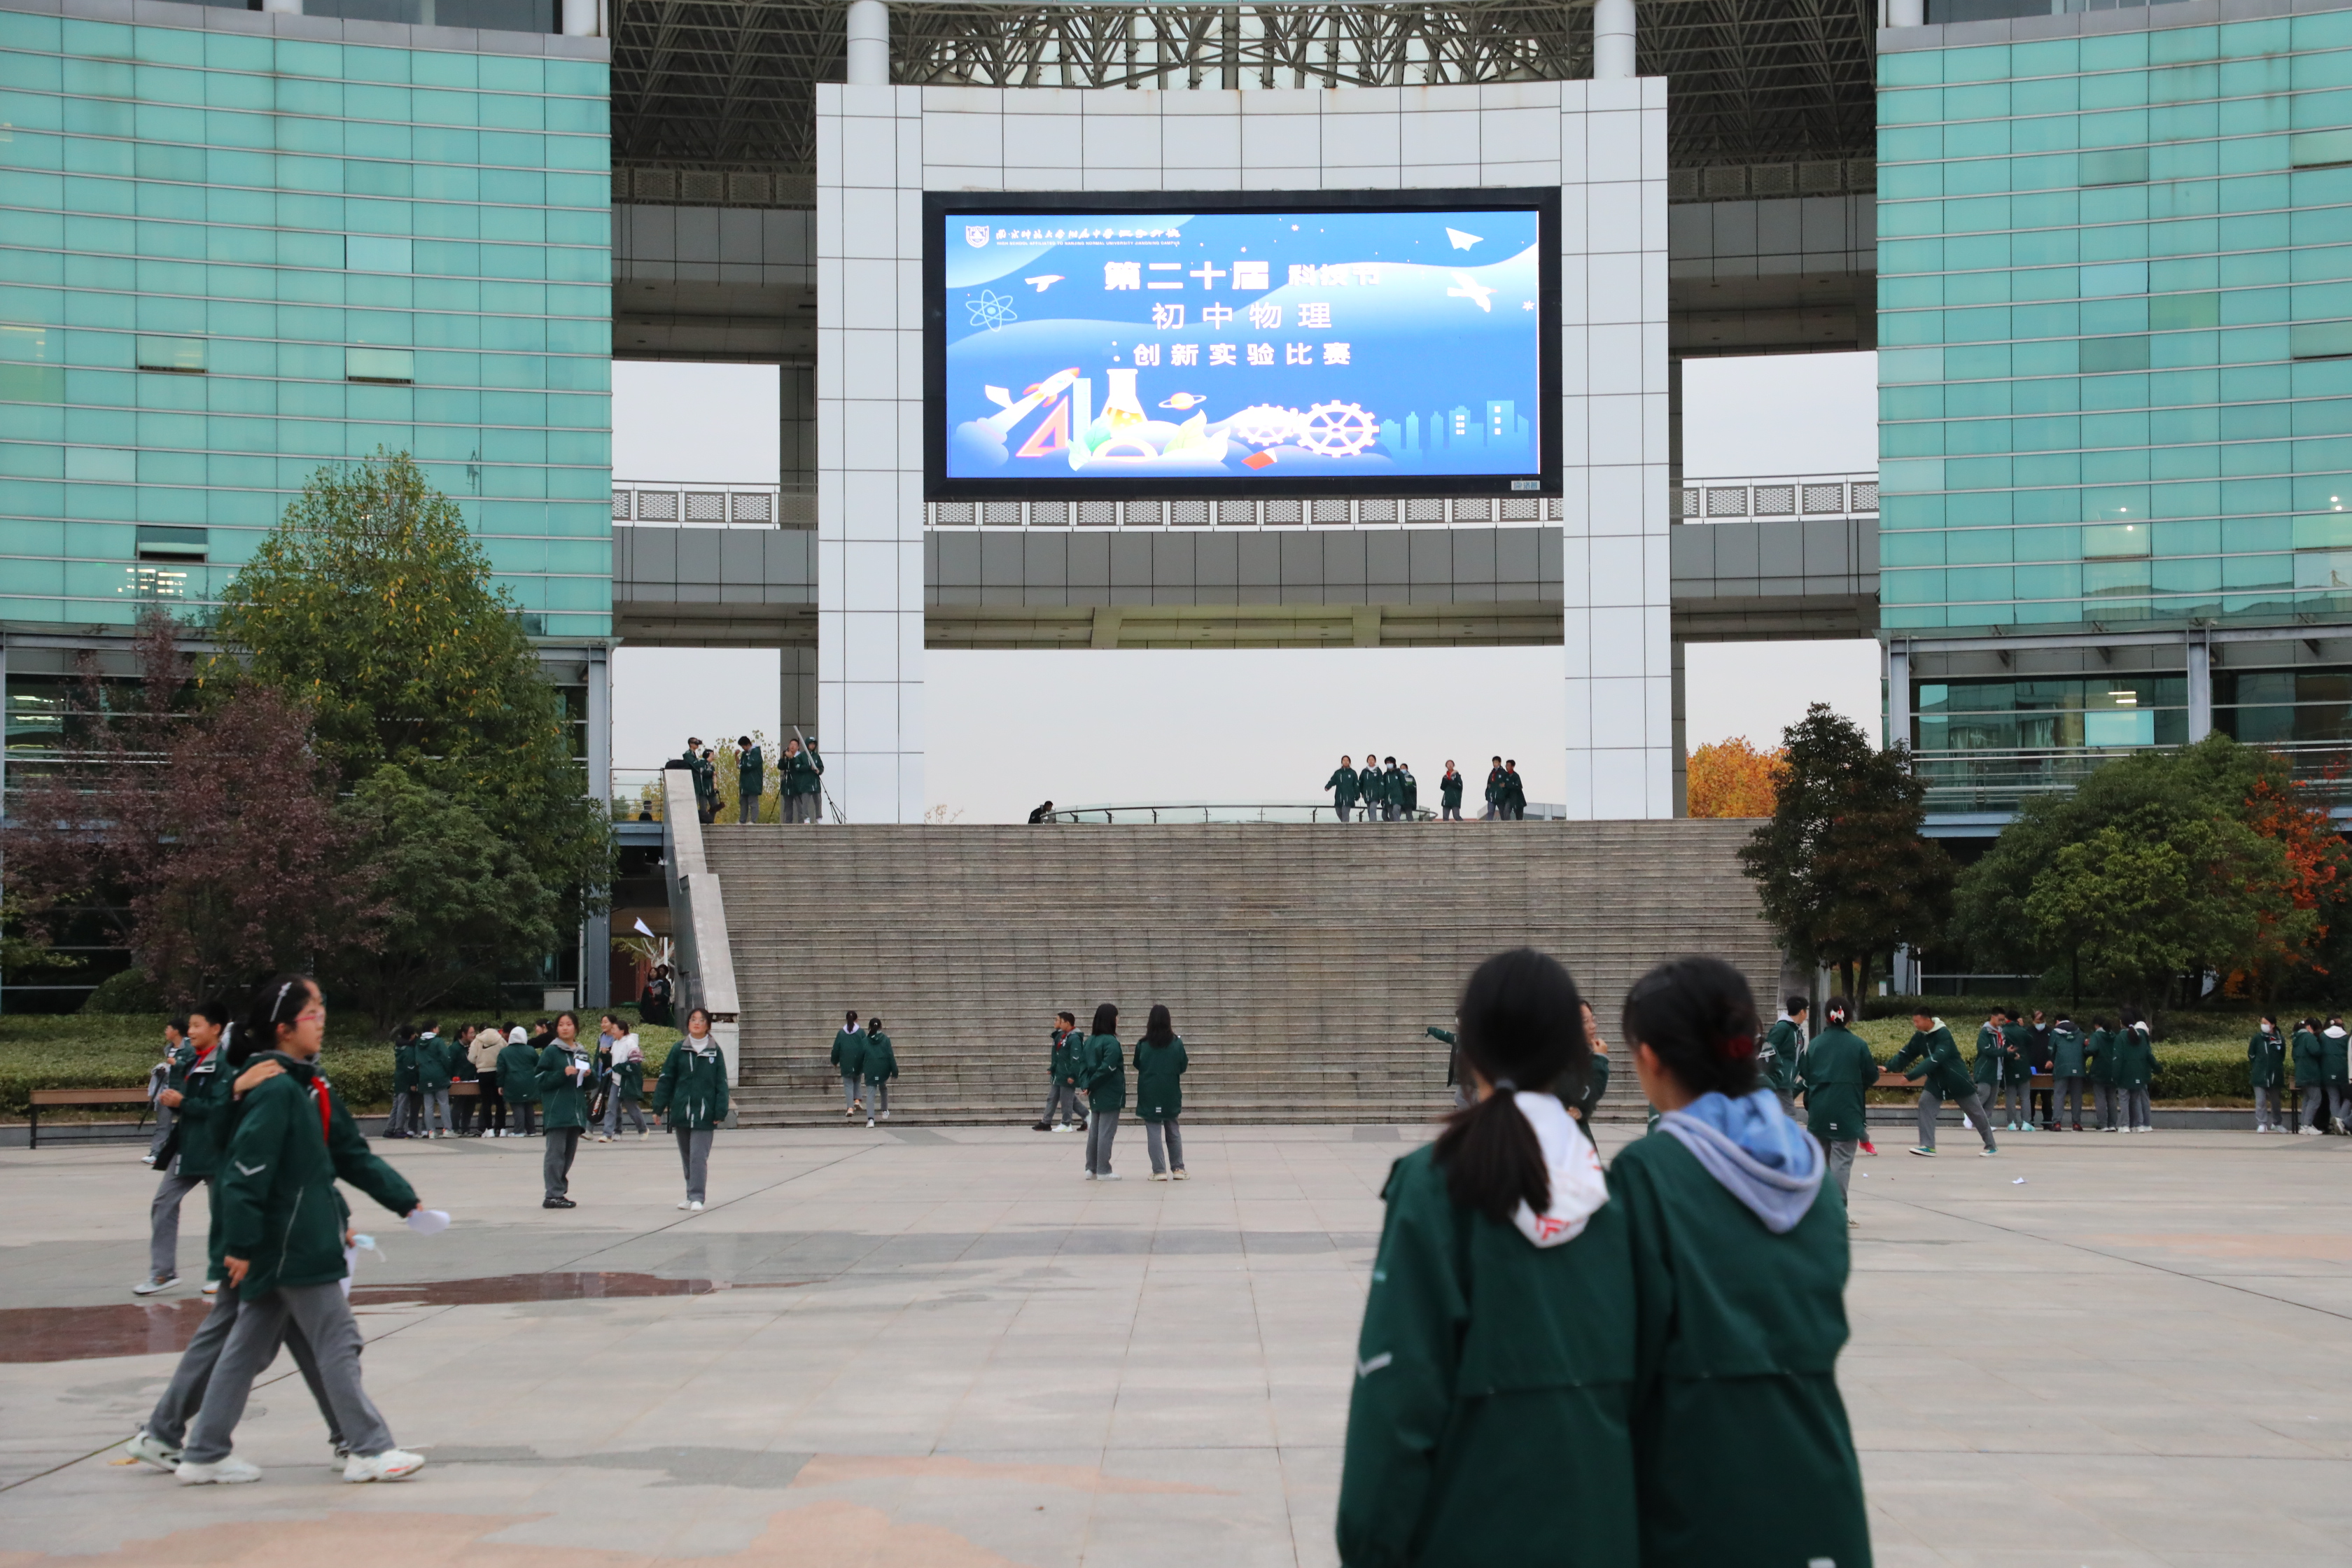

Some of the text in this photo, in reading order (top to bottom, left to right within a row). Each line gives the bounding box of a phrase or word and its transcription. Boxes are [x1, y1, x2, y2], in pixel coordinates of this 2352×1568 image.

[1104, 261, 1269, 290] 第二十届
[1152, 302, 1332, 330] 初中物理
[1133, 343, 1351, 366] 创新实验比赛
